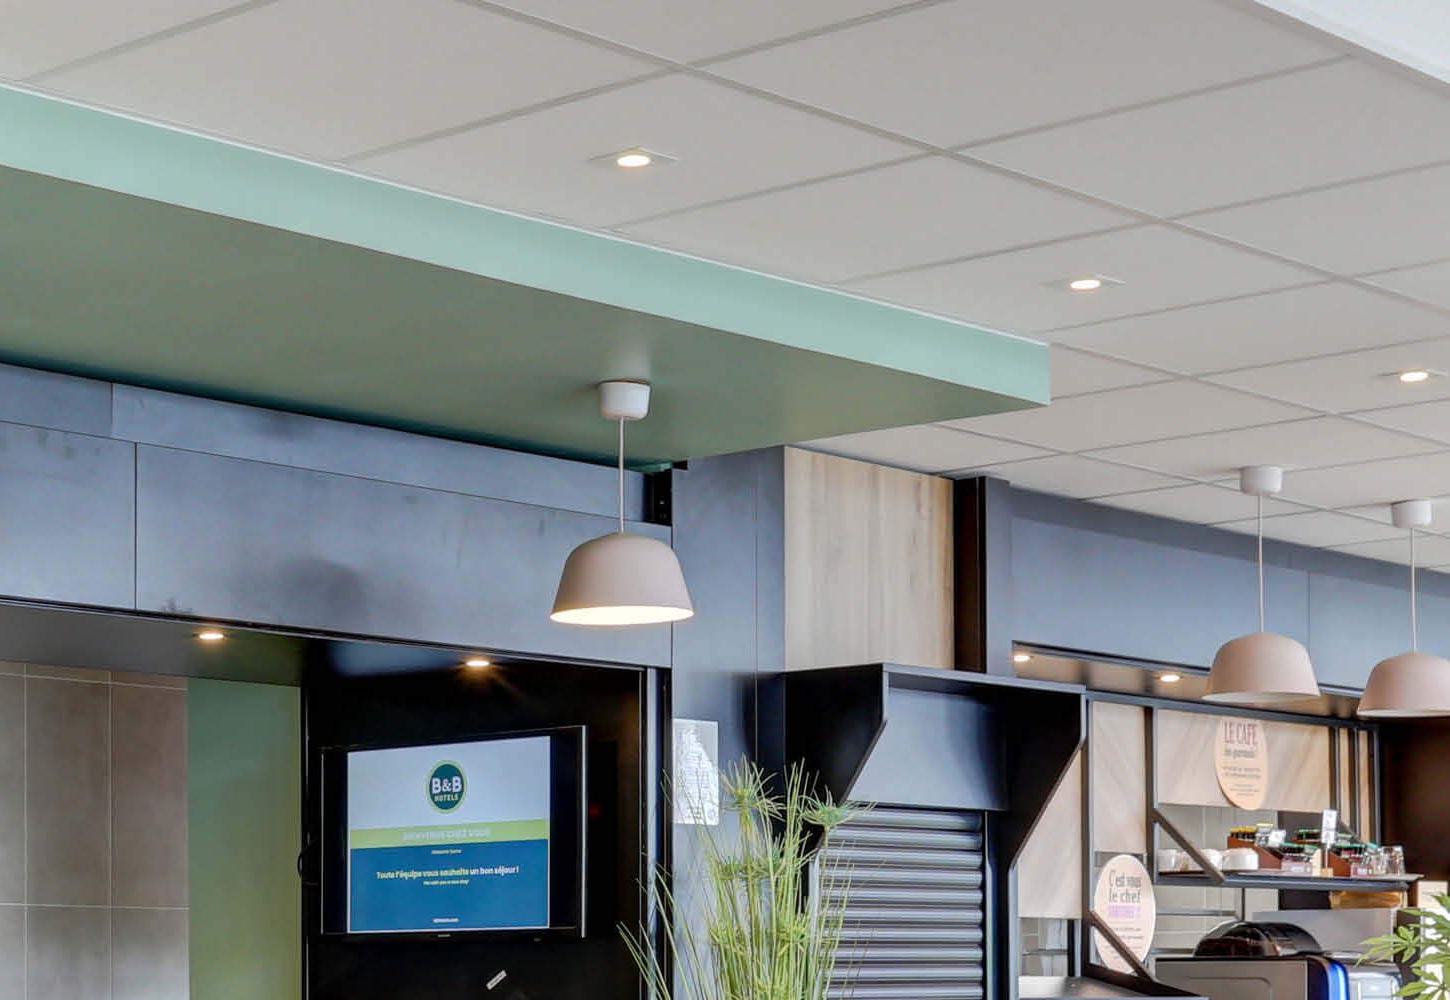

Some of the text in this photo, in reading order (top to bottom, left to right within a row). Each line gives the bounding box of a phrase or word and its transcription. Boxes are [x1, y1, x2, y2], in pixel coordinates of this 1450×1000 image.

[1224, 721, 1235, 744] LE
[432, 776, 462, 794] B&B
[434, 793, 459, 802] HOTELS
[470, 868, 479, 876] un
[480, 867, 493, 875] bon
[1109, 888, 1142, 903] le chef
